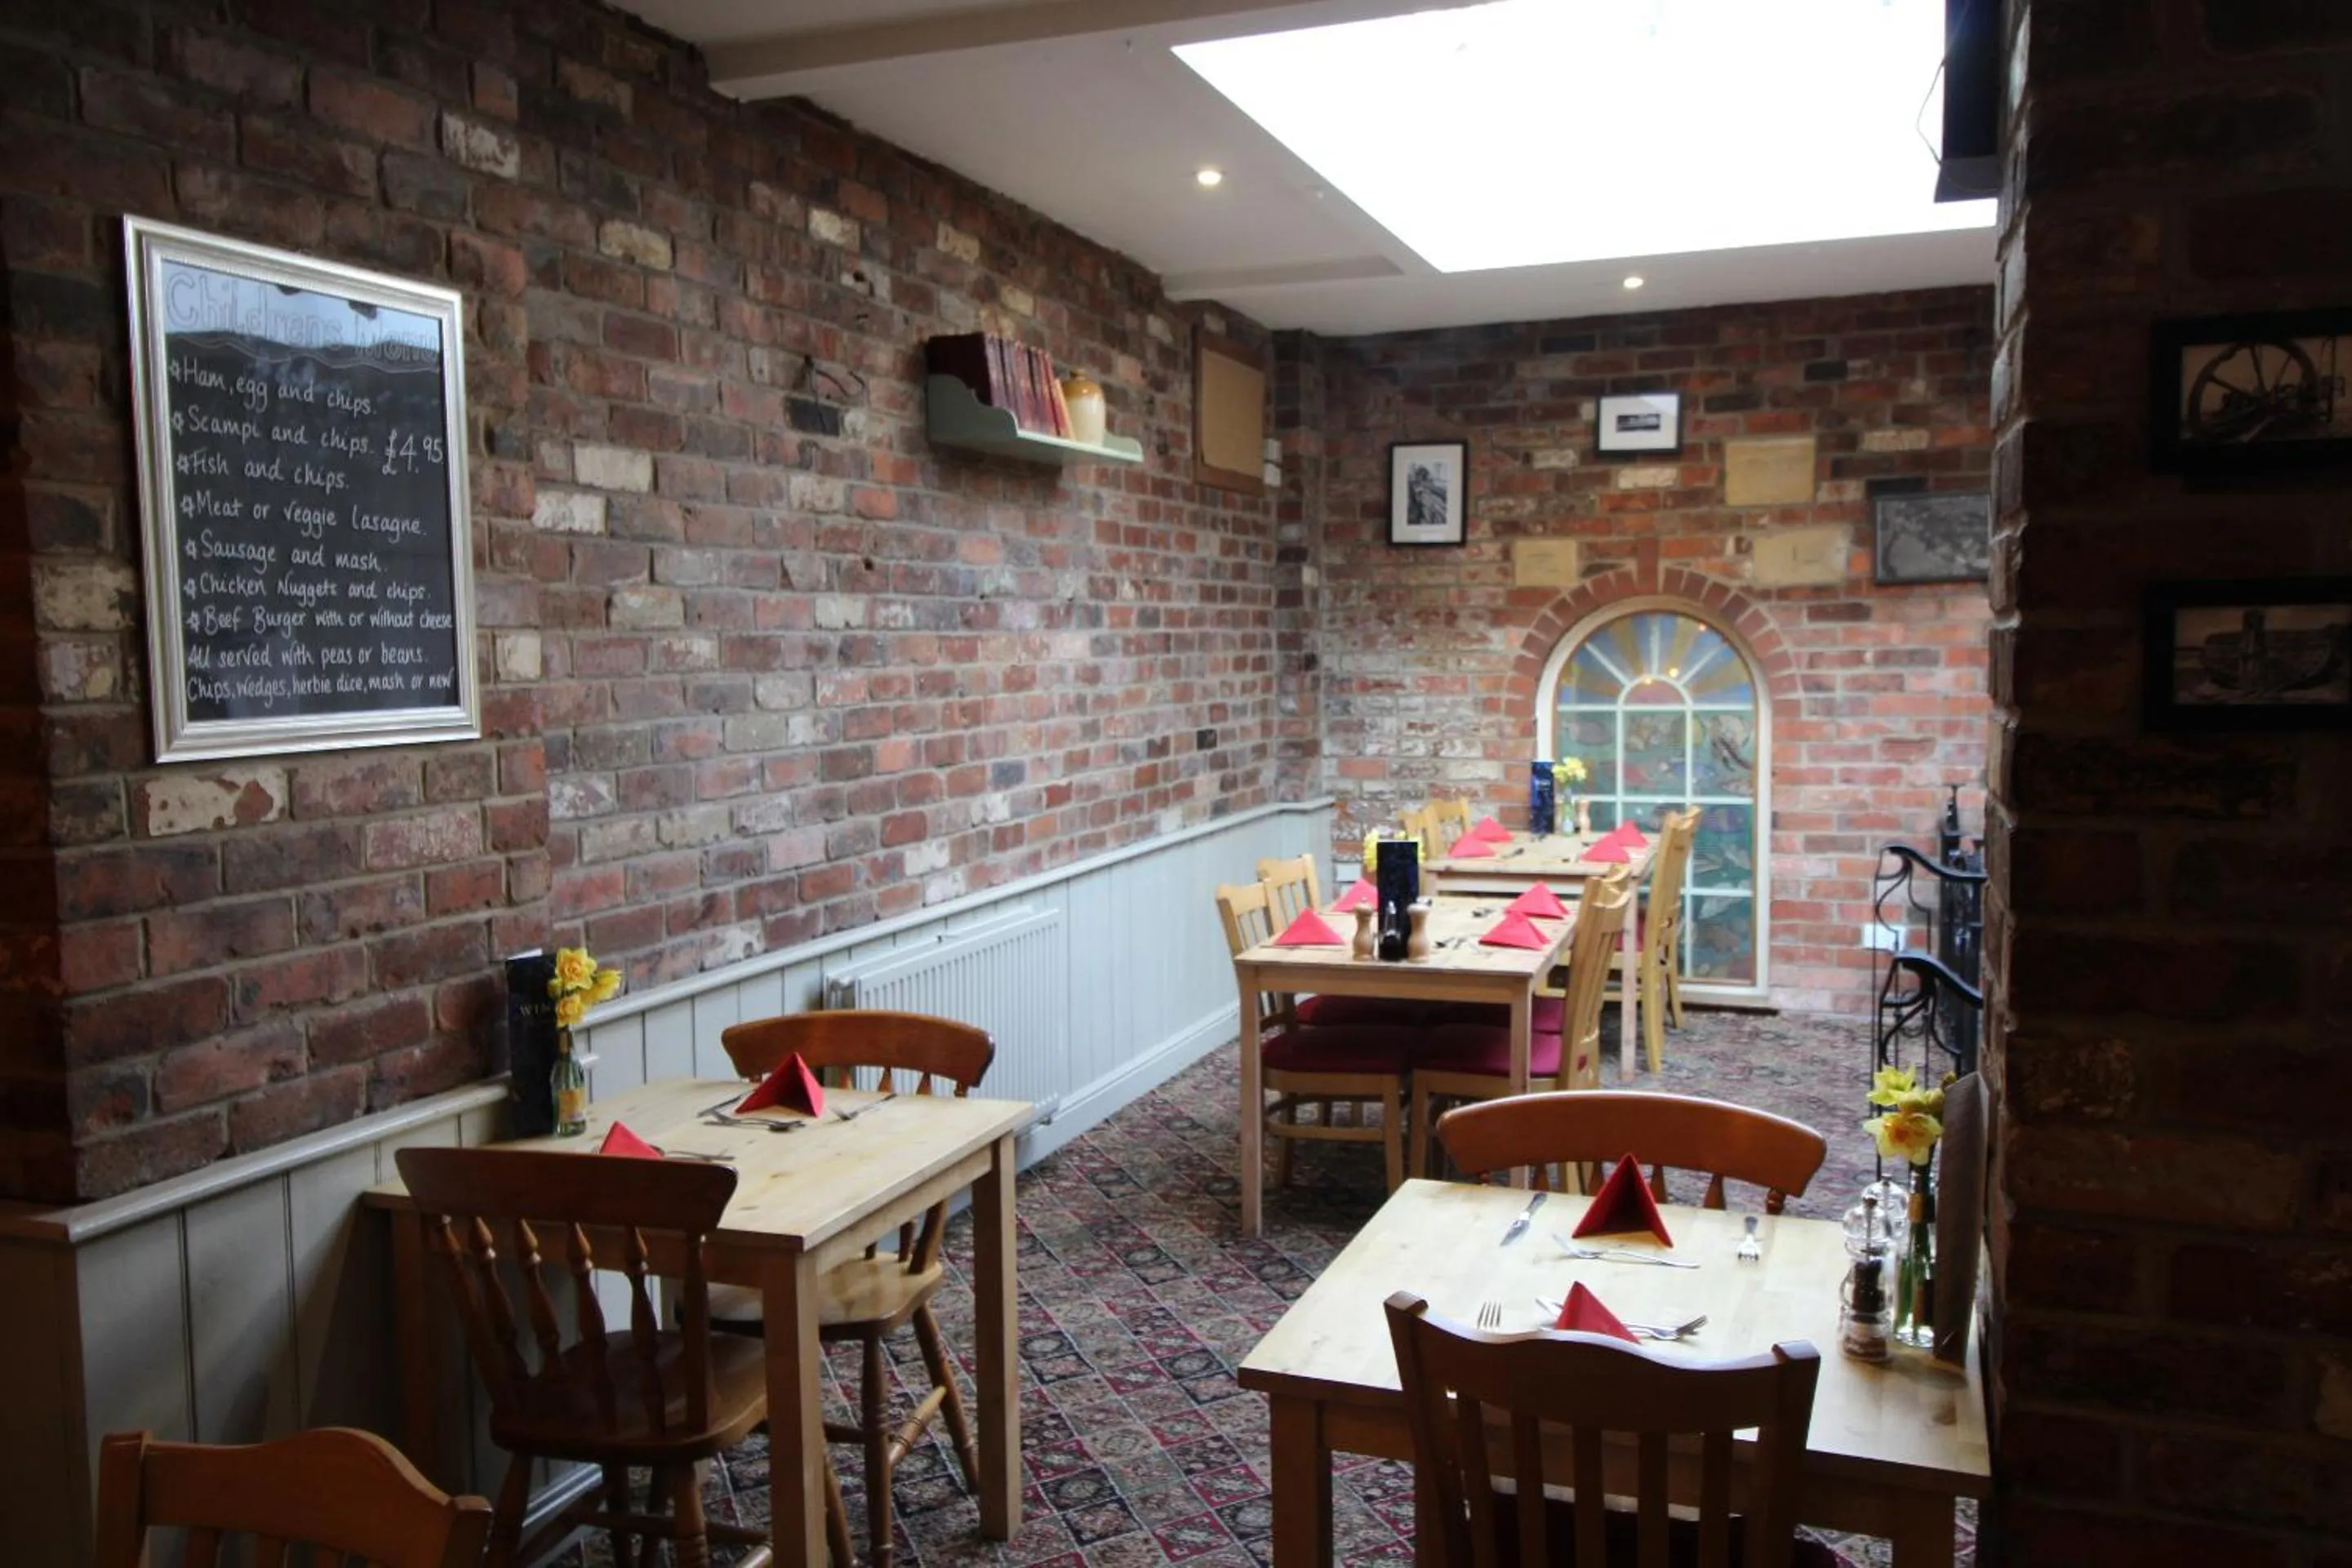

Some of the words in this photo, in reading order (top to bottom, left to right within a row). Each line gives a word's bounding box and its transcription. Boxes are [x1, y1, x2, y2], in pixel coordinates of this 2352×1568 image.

[236, 373, 268, 412] egg
[278, 380, 314, 403] and
[188, 404, 261, 446] Scampi
[272, 425, 308, 445] and
[189, 447, 229, 476] Fish
[244, 457, 285, 482] and
[196, 490, 243, 517] Meat
[253, 504, 270, 520] or
[201, 529, 277, 575] Sausage
[291, 544, 326, 566] and
[200, 572, 268, 598] Chicken
[349, 580, 377, 598] and
[203, 605, 242, 636] Beef
[251, 605, 306, 639] Burger
[349, 613, 365, 627] or
[188, 644, 211, 669] All
[218, 643, 273, 668] served
[321, 647, 353, 670] peas
[358, 646, 373, 664] or
[368, 672, 406, 691] mash
[411, 673, 424, 691] or
